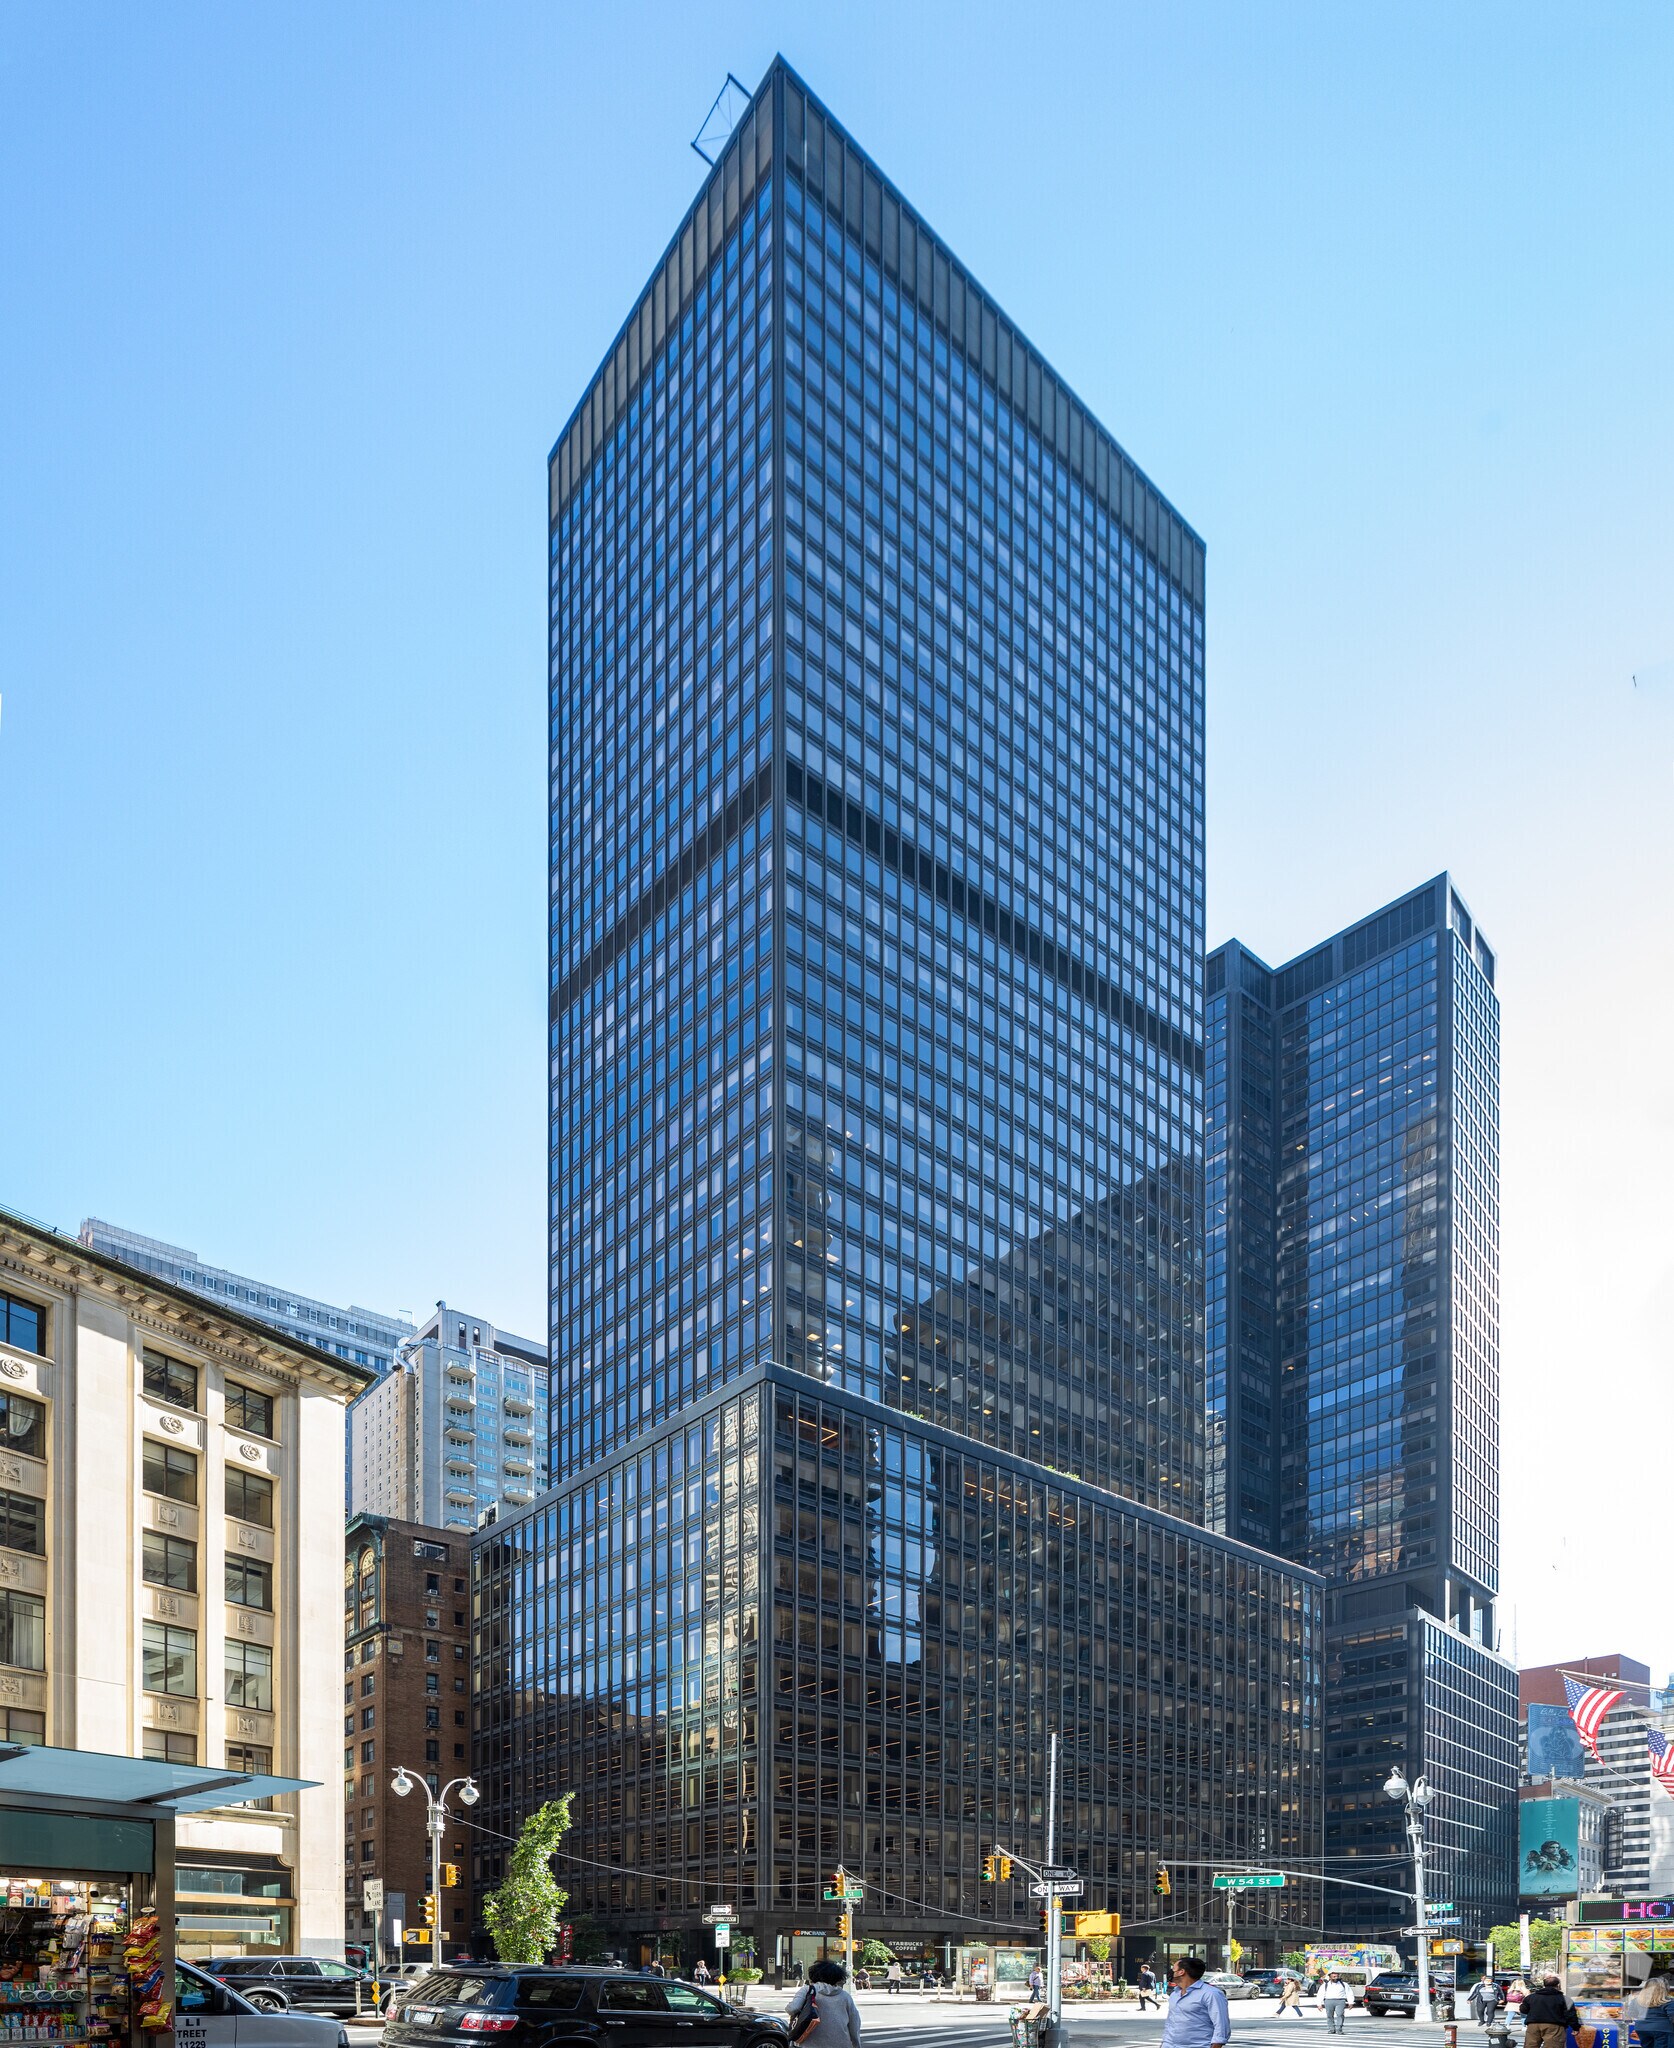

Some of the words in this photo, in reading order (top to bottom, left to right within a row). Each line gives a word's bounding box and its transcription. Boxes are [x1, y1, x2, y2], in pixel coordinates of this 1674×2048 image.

[1227, 1878, 1236, 1886] W
[1623, 1901, 1674, 1919] HO
[185, 2018, 201, 2027] LI
[175, 2029, 207, 2038] TREET
[178, 2040, 207, 2048] 11229
